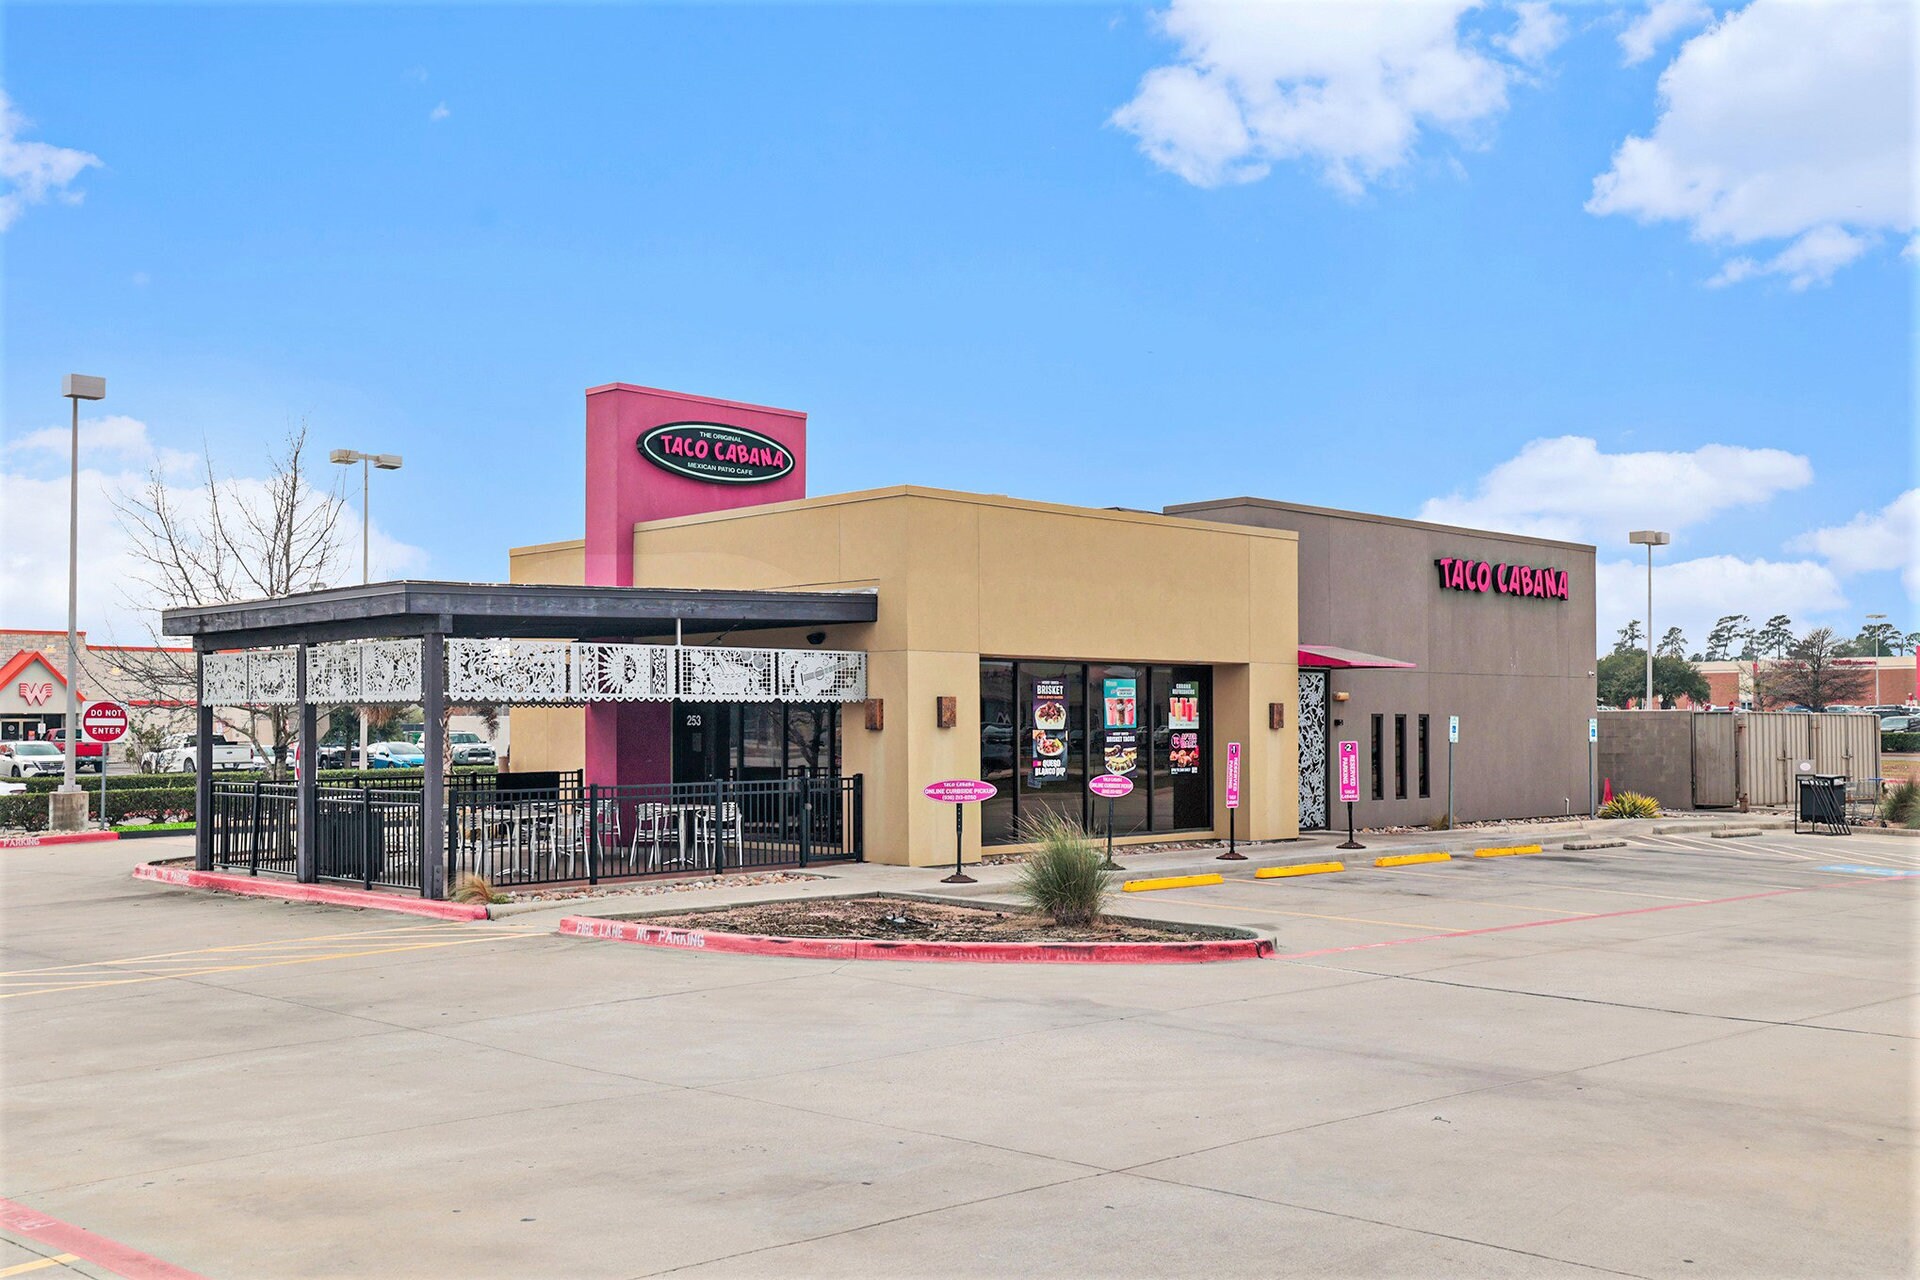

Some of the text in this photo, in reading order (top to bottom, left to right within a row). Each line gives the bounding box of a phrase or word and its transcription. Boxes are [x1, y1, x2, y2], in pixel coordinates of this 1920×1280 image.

[700, 431, 742, 443] THE ORIGINAL
[660, 435, 785, 469] TACO CABANA
[687, 462, 753, 476] MEXICAN PATIO CAFE
[1436, 557, 1568, 600] TACO CABANA
[1037, 685, 1064, 695] BRISKET
[91, 709, 122, 717] DO NOT
[686, 714, 702, 726] 253
[92, 727, 121, 735] ENTER
[1345, 743, 1352, 752] 2
[3, 838, 40, 847] PARKING
[576, 921, 705, 948] FIRE LANE NO PARKING
